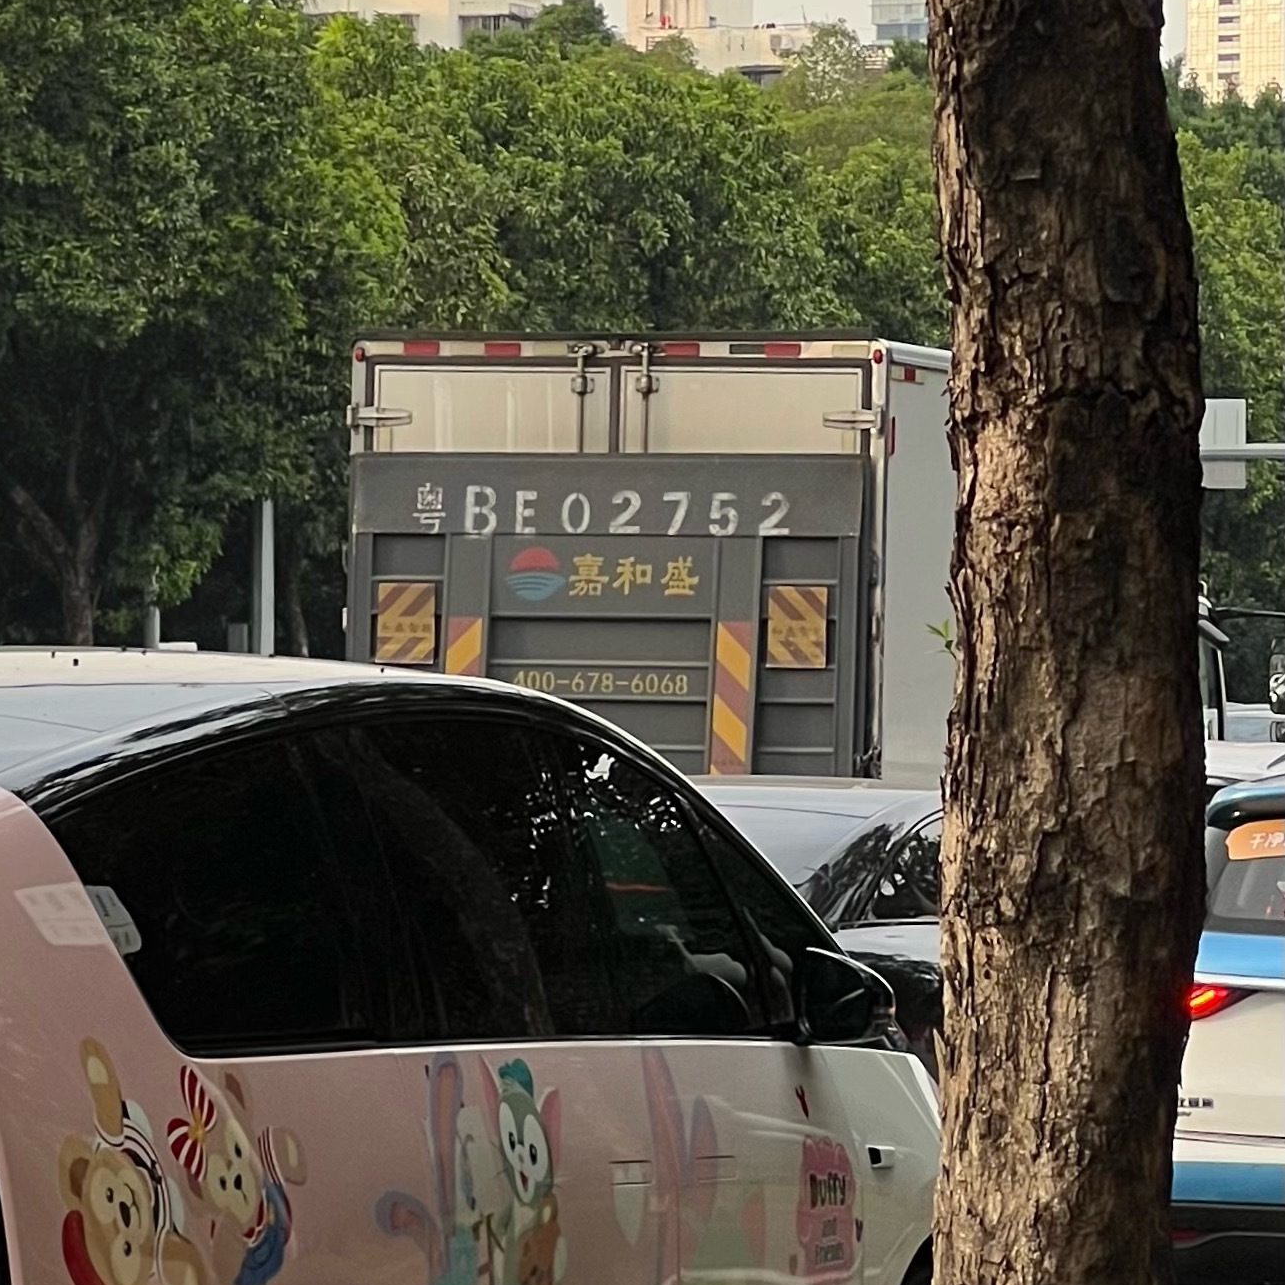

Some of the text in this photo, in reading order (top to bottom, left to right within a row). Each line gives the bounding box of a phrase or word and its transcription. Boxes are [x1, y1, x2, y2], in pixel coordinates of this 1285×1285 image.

[568, 553, 700, 597] 嘉和盛
[513, 670, 689, 695] 400-678-6068
